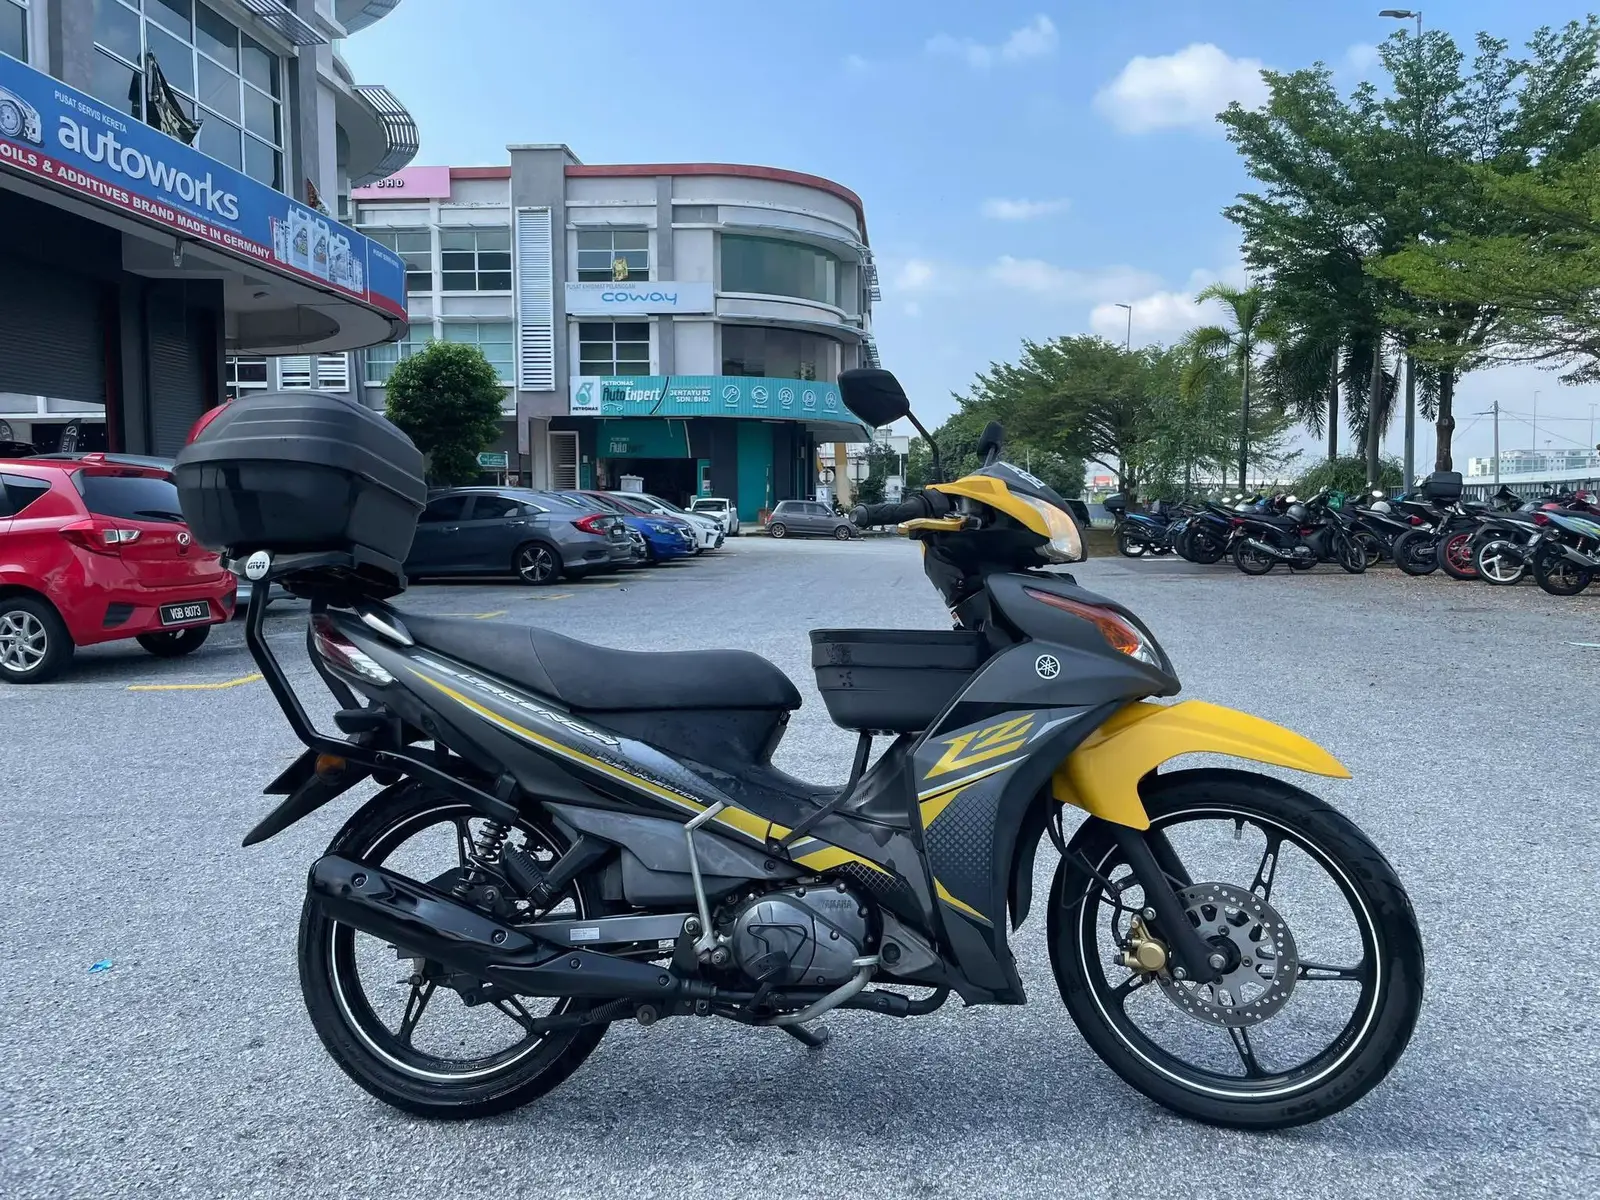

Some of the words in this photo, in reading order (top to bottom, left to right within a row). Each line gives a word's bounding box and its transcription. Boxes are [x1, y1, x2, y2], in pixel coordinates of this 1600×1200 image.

[54, 90, 77, 109] PUSAT
[78, 102, 101, 121] SERVIS
[101, 113, 127, 133] KERETA
[58, 115, 239, 221] autoworks
[377, 179, 405, 188] BHD
[0, 143, 38, 167] OILS
[42, 159, 53, 174] &
[57, 166, 129, 204] ADDITIVES
[132, 196, 175, 222] BRAND
[177, 214, 208, 236] MADE
[210, 227, 221, 241] IN
[223, 233, 270, 259] GERMANY
[602, 292, 678, 305] coway
[602, 387, 661, 402] AutoExpert
[247, 561, 266, 570] GIVI
[170, 607, 184, 620] VGB
[184, 605, 201, 617] 8073
[596, 756, 631, 774] FUEL
[633, 772, 703, 802] INJECTION
[820, 899, 851, 910] YAMAHA
